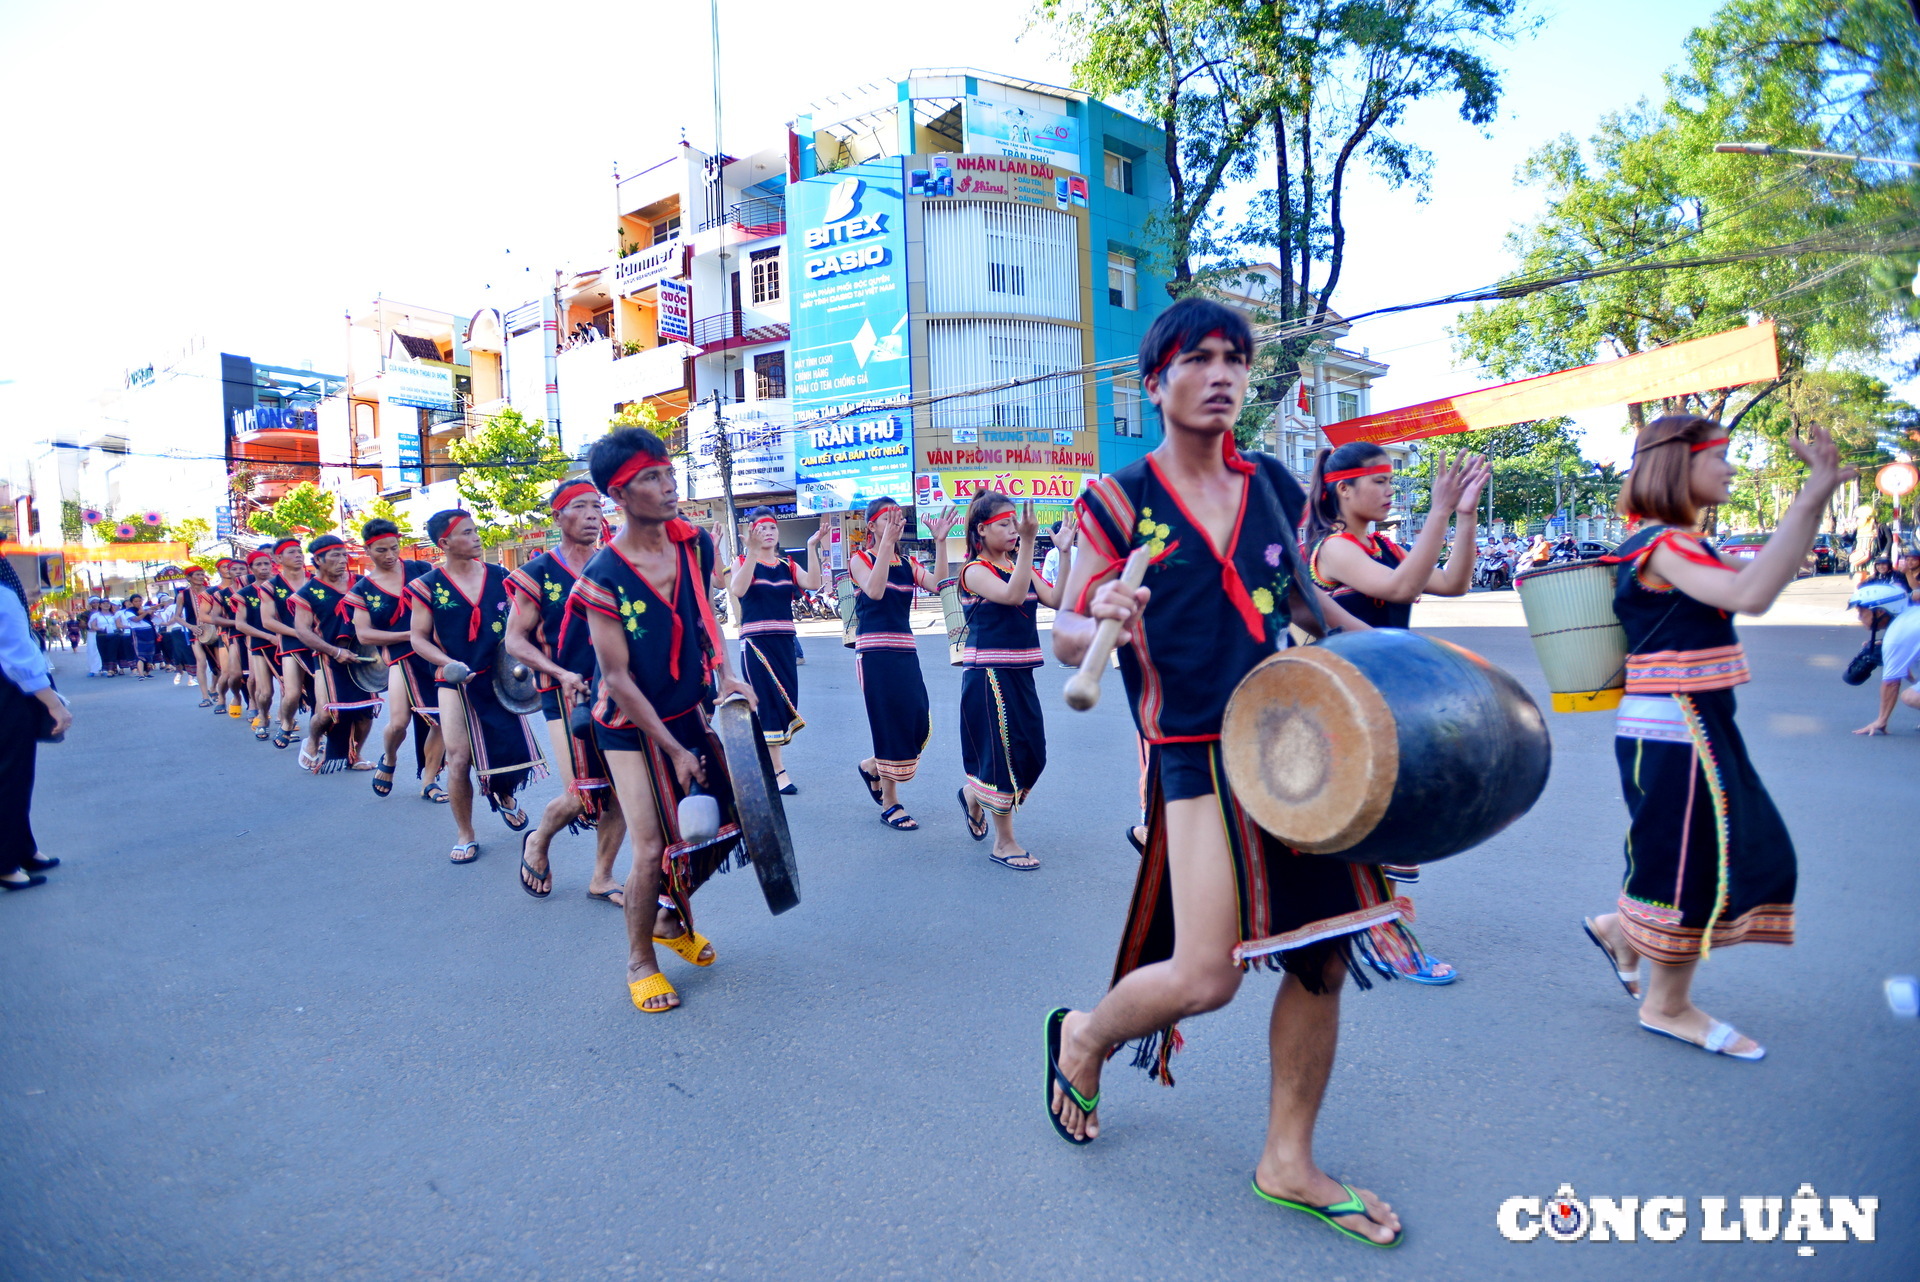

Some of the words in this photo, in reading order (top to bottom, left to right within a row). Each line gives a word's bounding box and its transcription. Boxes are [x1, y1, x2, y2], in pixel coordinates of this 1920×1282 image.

[956, 156, 996, 174] NHẬN
[1030, 164, 1054, 180] DẤU
[1018, 176, 1030, 184] DẤU
[804, 212, 887, 249] BITEX
[805, 244, 886, 280] CASIO
[661, 290, 686, 305] QUỐC
[794, 358, 806, 369] MÁY
[806, 356, 817, 367] TÍNH
[820, 354, 833, 364] CASIO
[795, 371, 811, 382] CHÍNH
[813, 368, 829, 378] HÃNG
[795, 382, 809, 394] PHẢI
[810, 381, 818, 392] CÓ
[820, 381, 832, 390] TEM
[834, 374, 856, 388] CHỐNG
[857, 371, 868, 384] GIẢ
[244, 402, 296, 432] PHÒNG
[794, 410, 820, 422] TRUNG
[821, 405, 839, 417] TÂM
[808, 421, 855, 448] TRẦN
[860, 414, 897, 442] PHÚ
[982, 430, 1024, 442] TRUNG
[1026, 430, 1049, 442] TÂM
[800, 456, 818, 466] CAM
[818, 452, 832, 464] KẾT
[834, 451, 847, 462] GIÁ
[849, 449, 865, 460] BÁN
[867, 446, 883, 458] TỐT
[884, 443, 906, 456] NHẤT
[927, 448, 953, 465] VĂN
[956, 446, 1002, 464] PHÒNG
[1006, 444, 1042, 464] PHẨM
[1044, 446, 1073, 465] TRẦN
[1075, 451, 1094, 467] PHÚ
[954, 473, 1024, 497] KHẮC
[1032, 474, 1074, 497] DẤU
